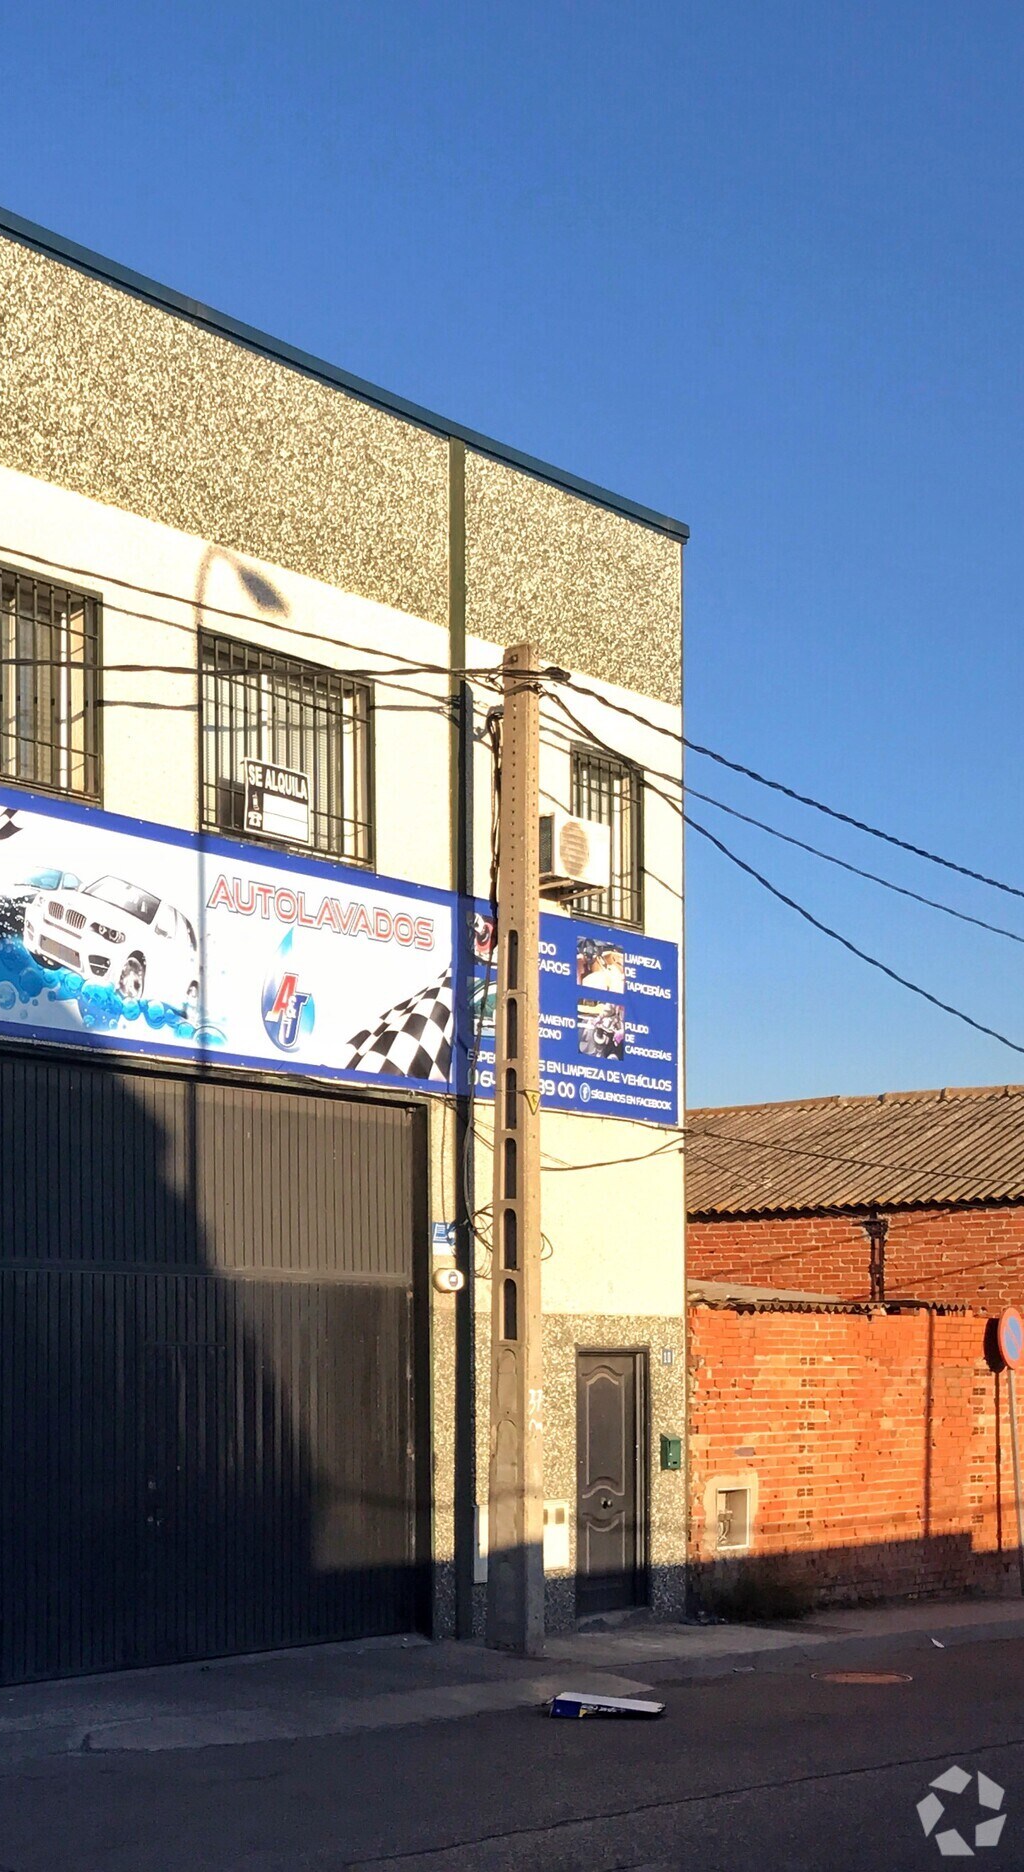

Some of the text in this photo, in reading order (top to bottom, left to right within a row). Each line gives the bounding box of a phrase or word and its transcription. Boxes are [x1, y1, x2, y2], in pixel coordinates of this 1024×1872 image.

[248, 764, 308, 801] SE ALQUILA
[207, 874, 435, 951] AUTOLAVADOS
[624, 952, 662, 971] LIMPIEZA
[624, 966, 637, 979] DE
[625, 980, 671, 1000] TAPICERÍAS
[538, 1027, 562, 1041] ZONO
[624, 1021, 649, 1035] PULIDO
[624, 1033, 635, 1044] DE
[624, 1044, 672, 1062] CARROCERÍAS
[546, 1061, 562, 1074] EN
[561, 1062, 606, 1082] LIMPIEZA
[606, 1070, 621, 1084] DE
[620, 1071, 673, 1092] VEHÍCULOS
[557, 1080, 576, 1099] 00
[590, 1088, 673, 1111] SÍGUENOS EN FACEBOOK
